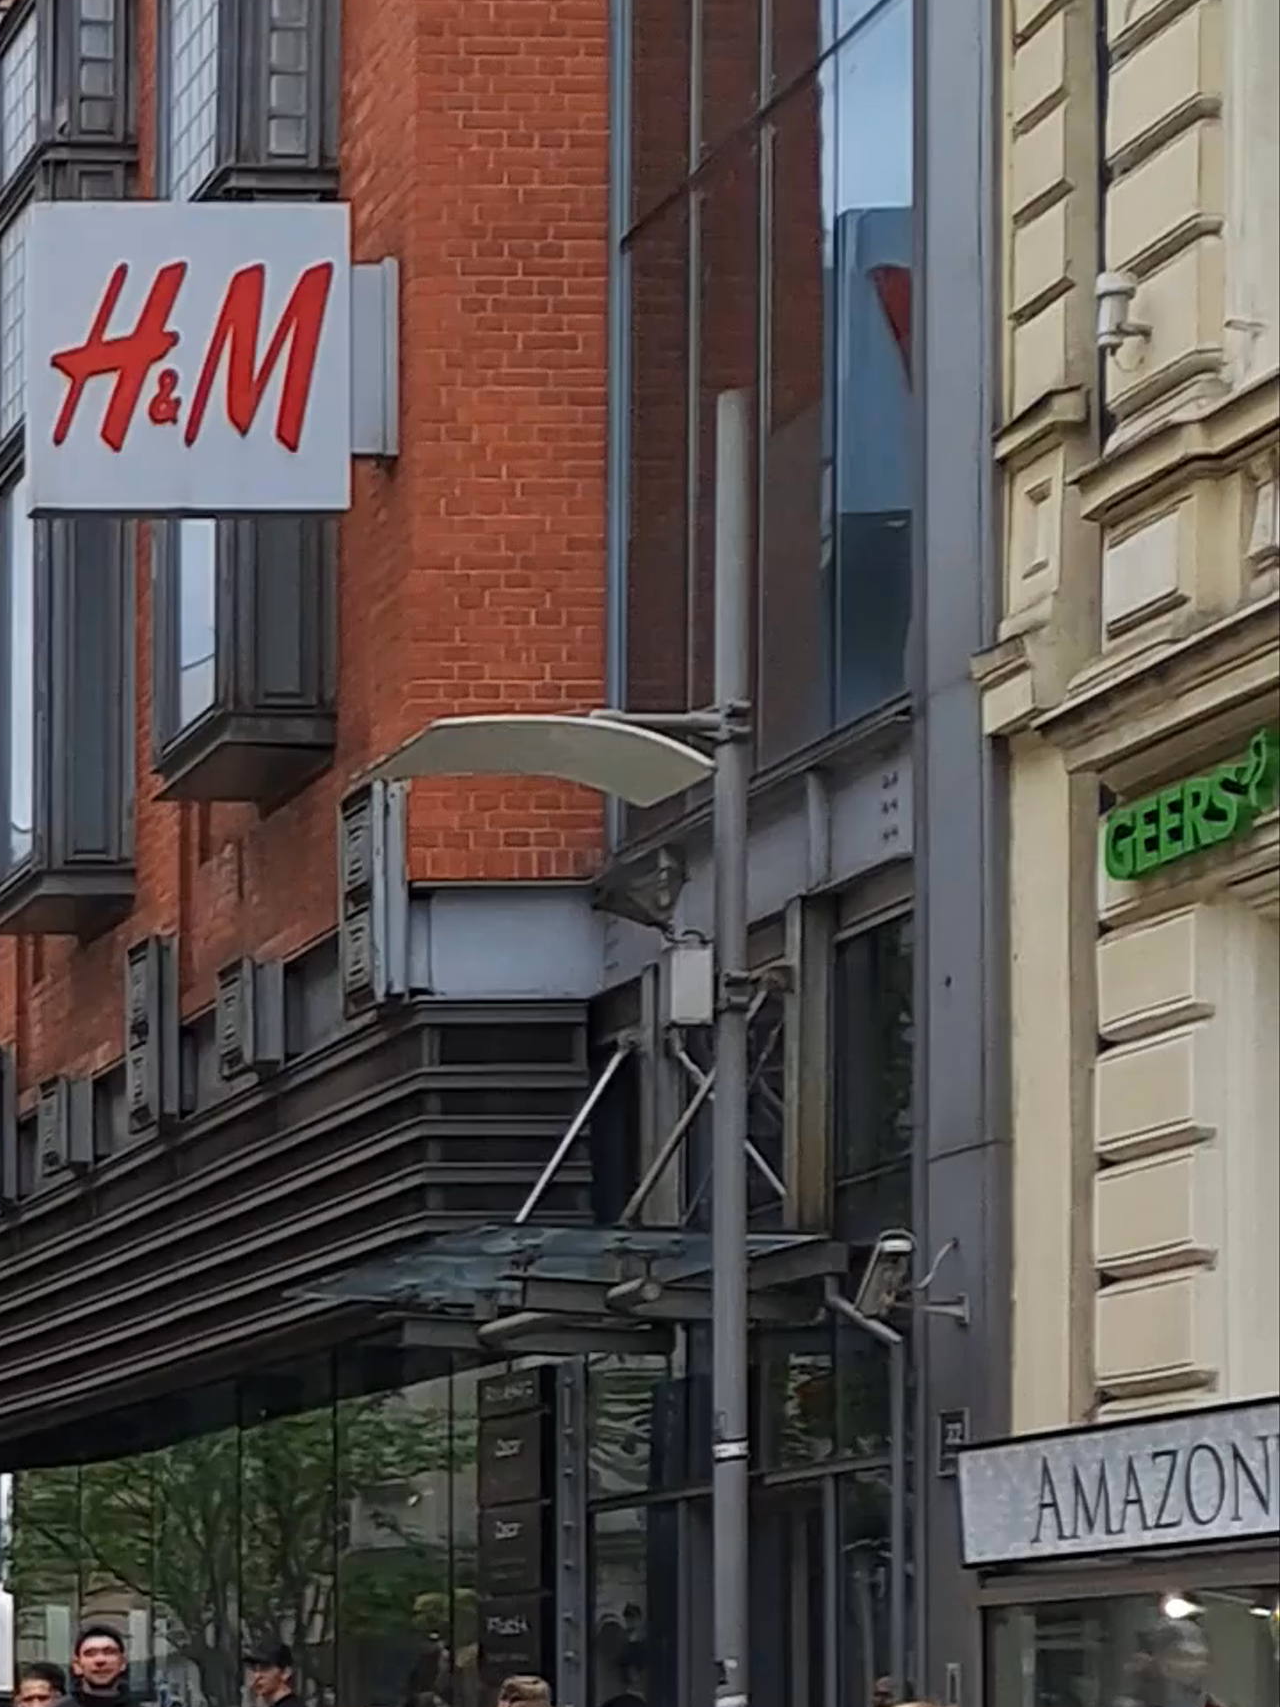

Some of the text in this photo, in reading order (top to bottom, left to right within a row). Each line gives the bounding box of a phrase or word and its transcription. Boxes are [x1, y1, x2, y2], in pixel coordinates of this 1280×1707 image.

[50, 261, 335, 453] H&M
[1105, 763, 1248, 881] GEERS
[1030, 1433, 1279, 1543] AMAZON
